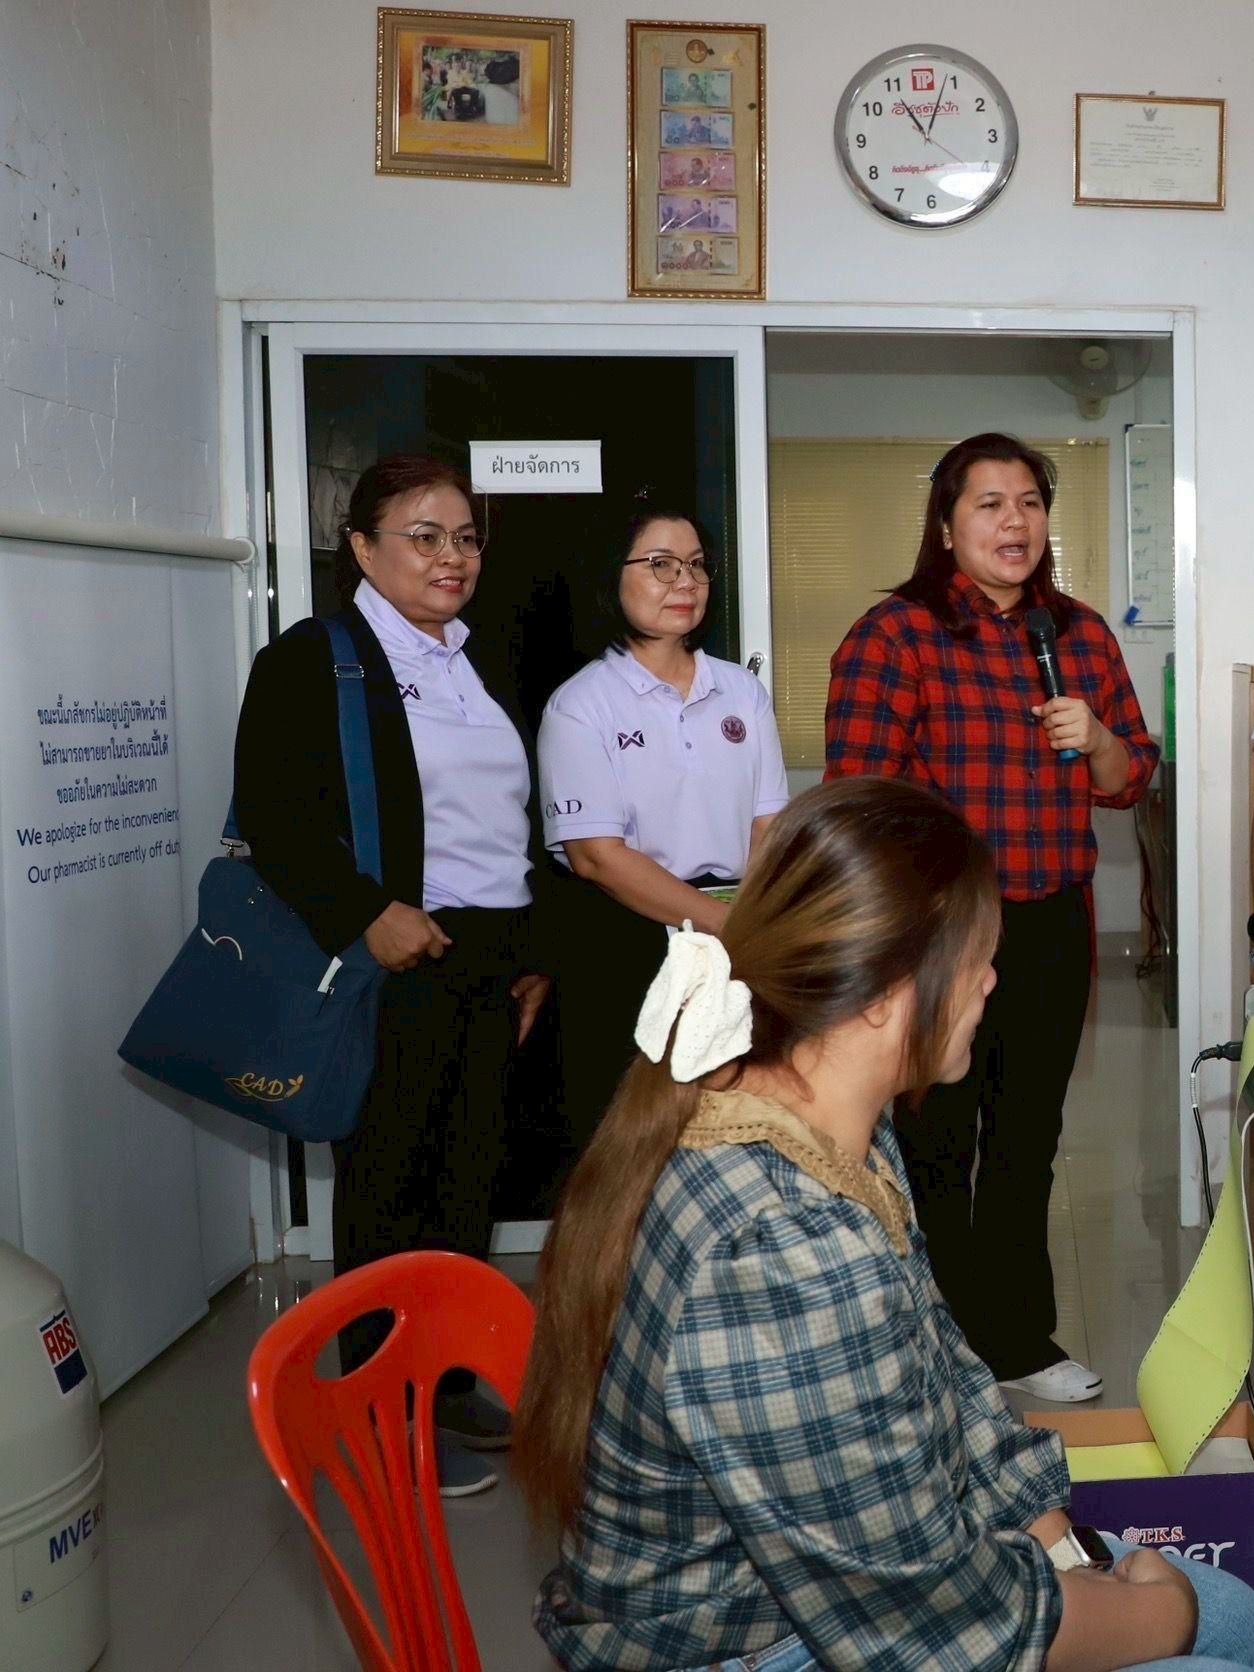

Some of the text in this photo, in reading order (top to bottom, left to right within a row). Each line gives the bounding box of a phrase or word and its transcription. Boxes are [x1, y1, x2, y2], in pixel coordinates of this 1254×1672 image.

[884, 77, 901, 92] 11
[950, 75, 958, 90] 1
[863, 101, 883, 117] 10
[975, 97, 986, 112] 2
[856, 133, 867, 148] 9
[987, 128, 998, 143] 3
[868, 165, 879, 180] 8
[894, 187, 905, 202] 7
[926, 194, 937, 209] 6
[492, 454, 581, 474] ฝ่ายจัดการ
[37, 694, 168, 730] ขณะนี้เภสัชกรไม่อยู่ปฏิบัติหน้าที่
[39, 729, 169, 766] ไม่สามารถขายยาในบริเวณนี้ได้
[56, 773, 158, 804] ขออภัยในความไม่สะดวก
[545, 798, 582, 819] CAD
[16, 827, 43, 847] We
[45, 820, 87, 847] apologize
[89, 817, 101, 835] for
[105, 815, 120, 833] the
[28, 865, 51, 884] Our
[53, 855, 97, 884] pharmacist
[99, 852, 106, 869] is
[108, 844, 147, 868] currently
[149, 840, 162, 858] off
[240, 1072, 285, 1096] CAD
[42, 1316, 78, 1366] ABS
[49, 1508, 93, 1564] MVE
